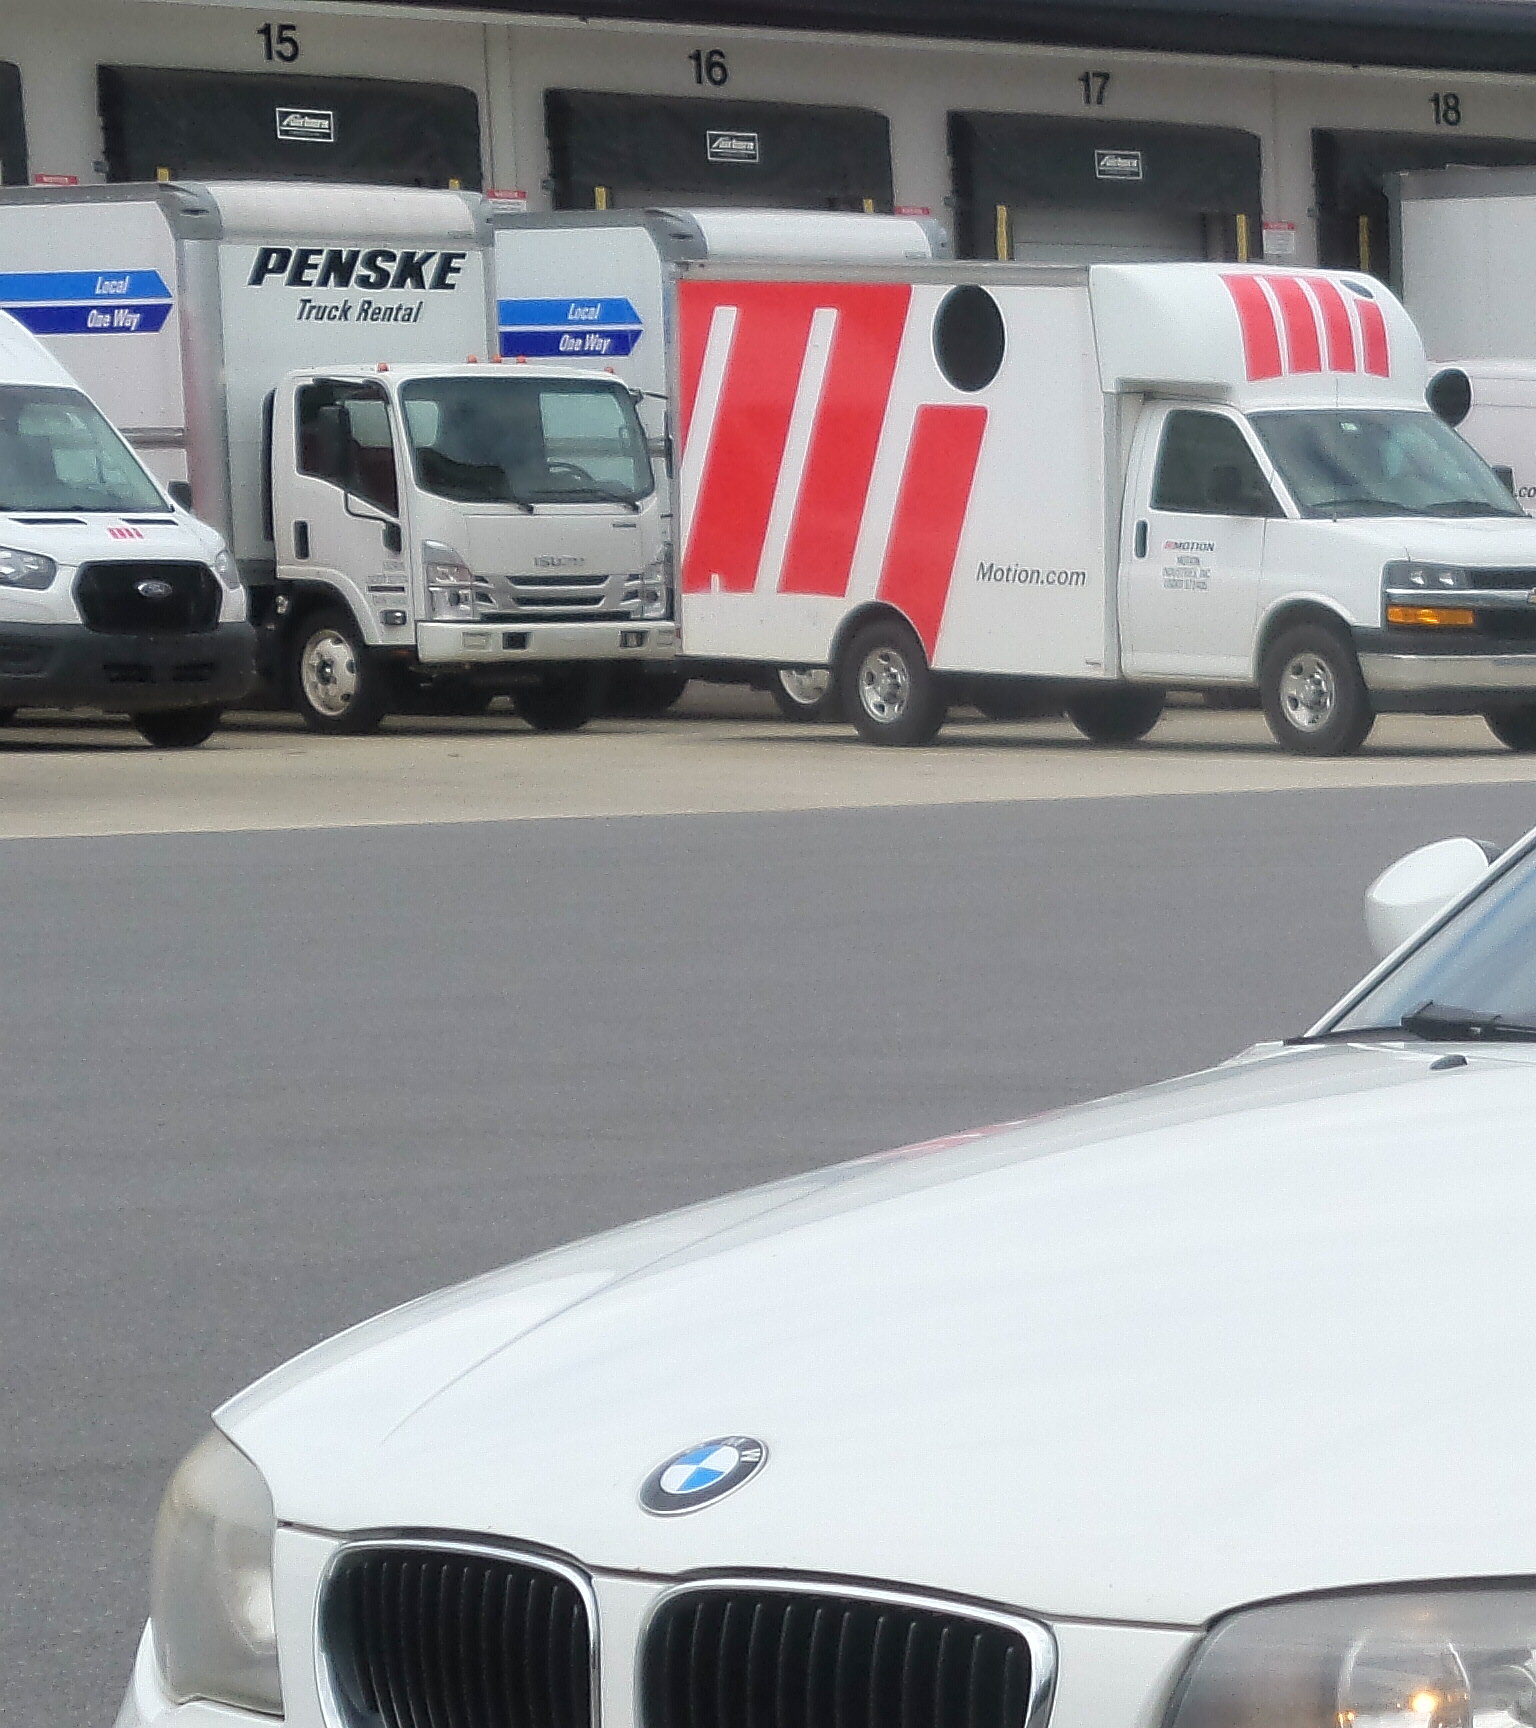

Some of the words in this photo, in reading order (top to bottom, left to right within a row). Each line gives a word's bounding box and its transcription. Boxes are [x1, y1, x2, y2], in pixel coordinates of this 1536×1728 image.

[256, 23, 299, 62] 15
[688, 49, 728, 86] 16
[1078, 72, 1110, 105] 17
[1430, 93, 1461, 126] 18
[247, 246, 467, 290] PENSKE
[95, 276, 130, 294] Local
[87, 309, 111, 328] One
[113, 309, 140, 331] Way
[297, 299, 351, 321] Truck
[356, 300, 423, 323] Rental
[568, 303, 601, 320] Local
[560, 334, 582, 351] One
[584, 333, 611, 354] Way
[976, 561, 1086, 586] Motion.com
